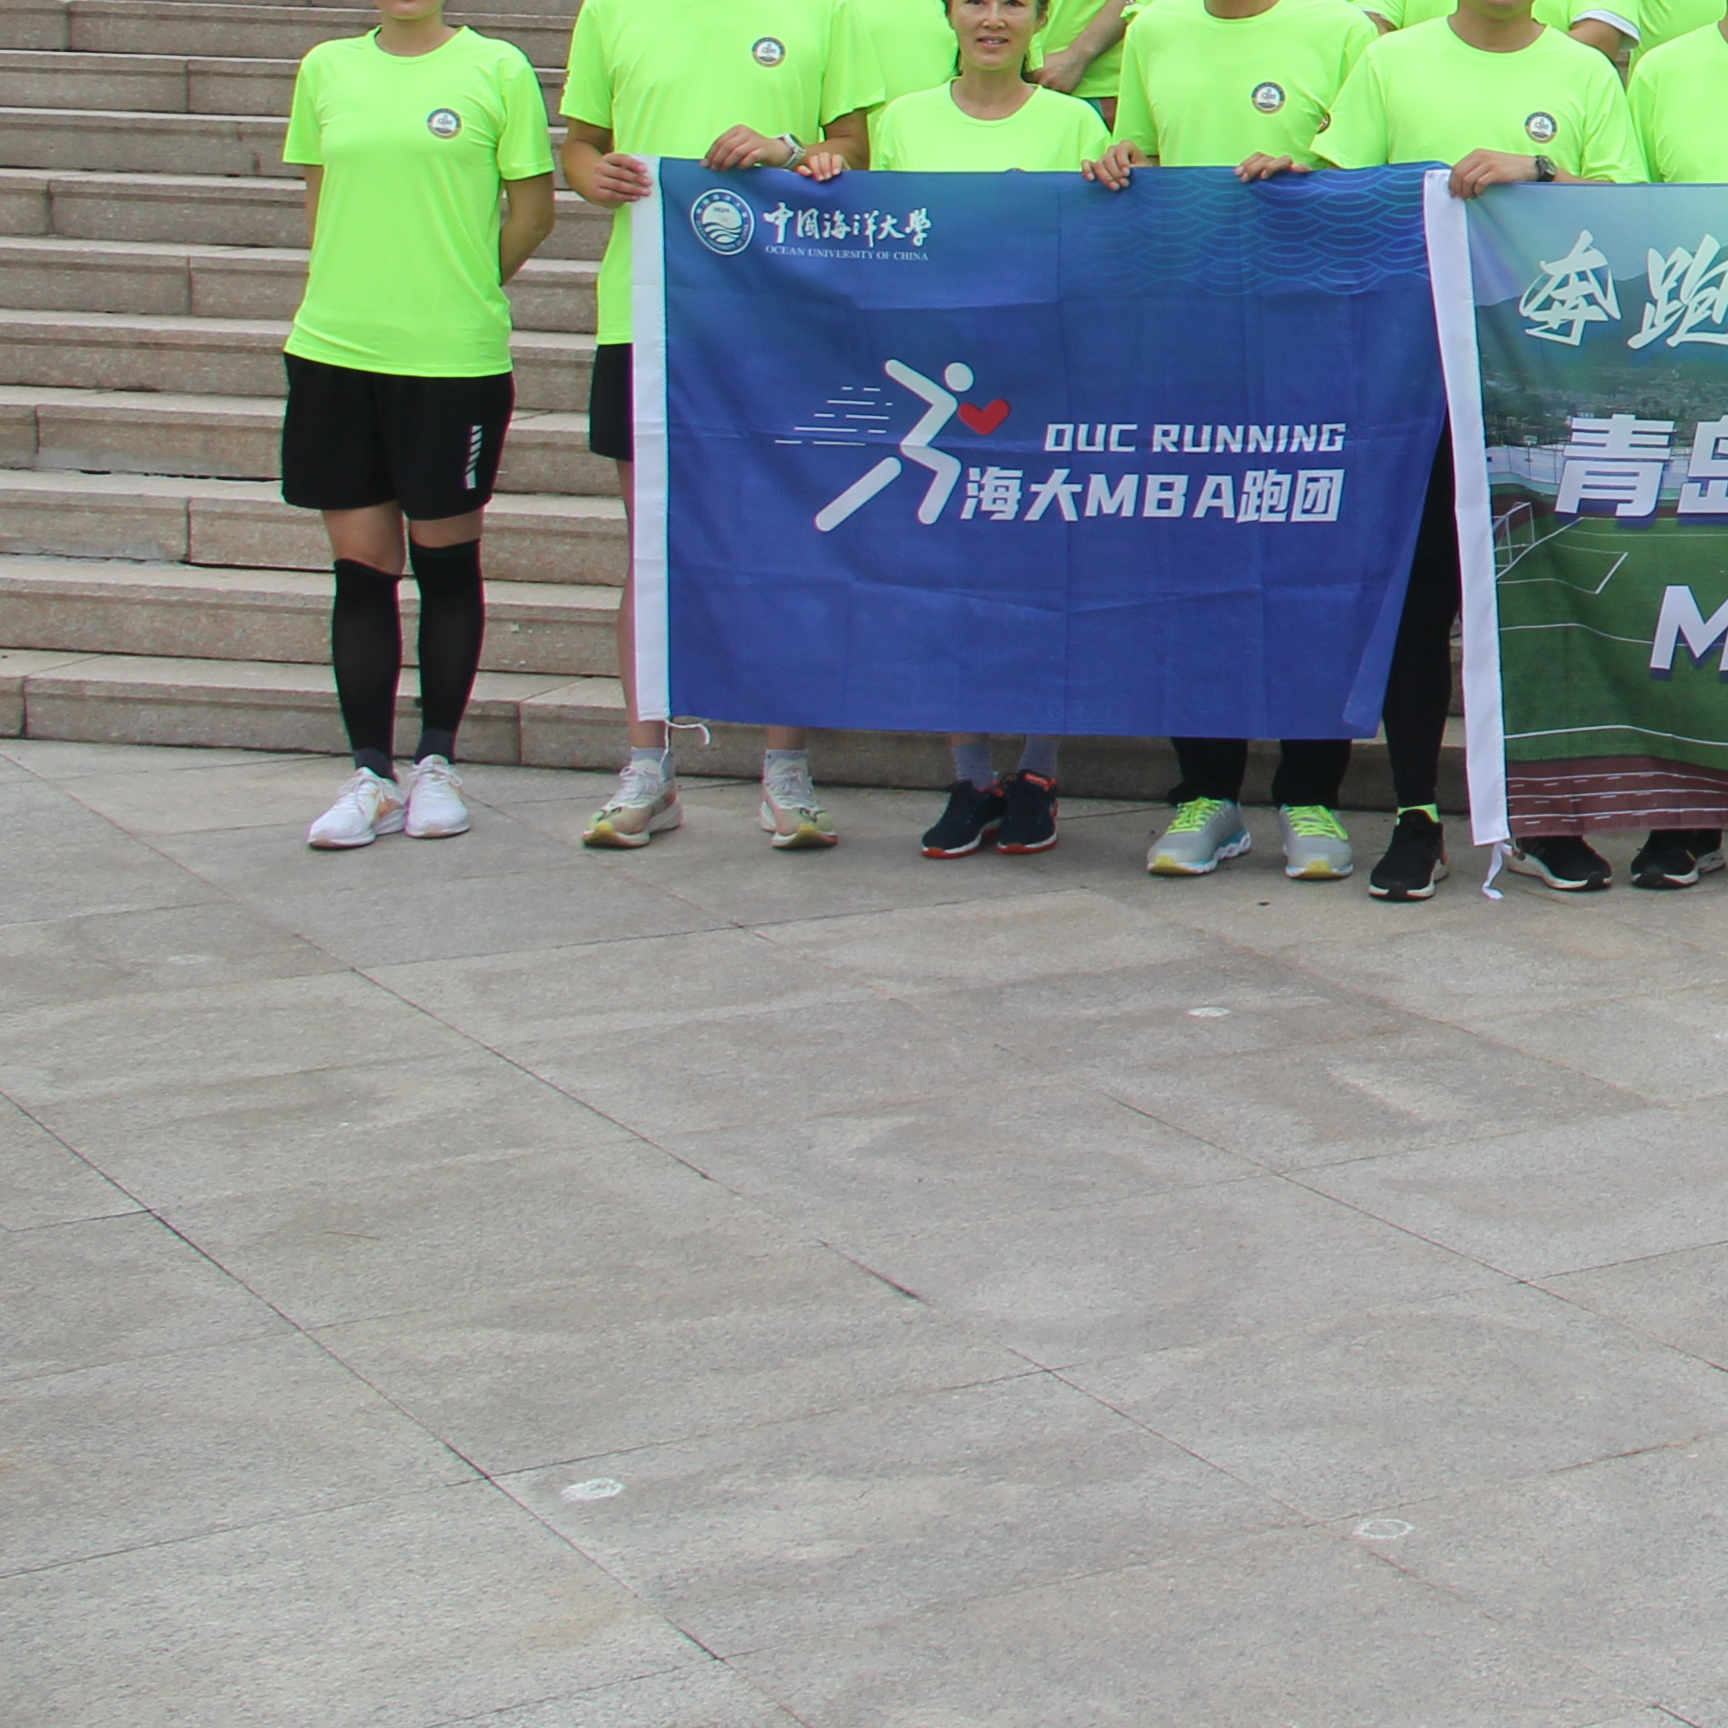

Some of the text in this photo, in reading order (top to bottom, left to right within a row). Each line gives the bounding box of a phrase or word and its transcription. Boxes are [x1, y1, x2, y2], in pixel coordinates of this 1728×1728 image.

[765, 245, 929, 261] OCEAN UNIVERSITY OF CHINA
[1044, 423, 1346, 453] OUC RUNNING
[960, 466, 1345, 523] 海大MBA跑团
